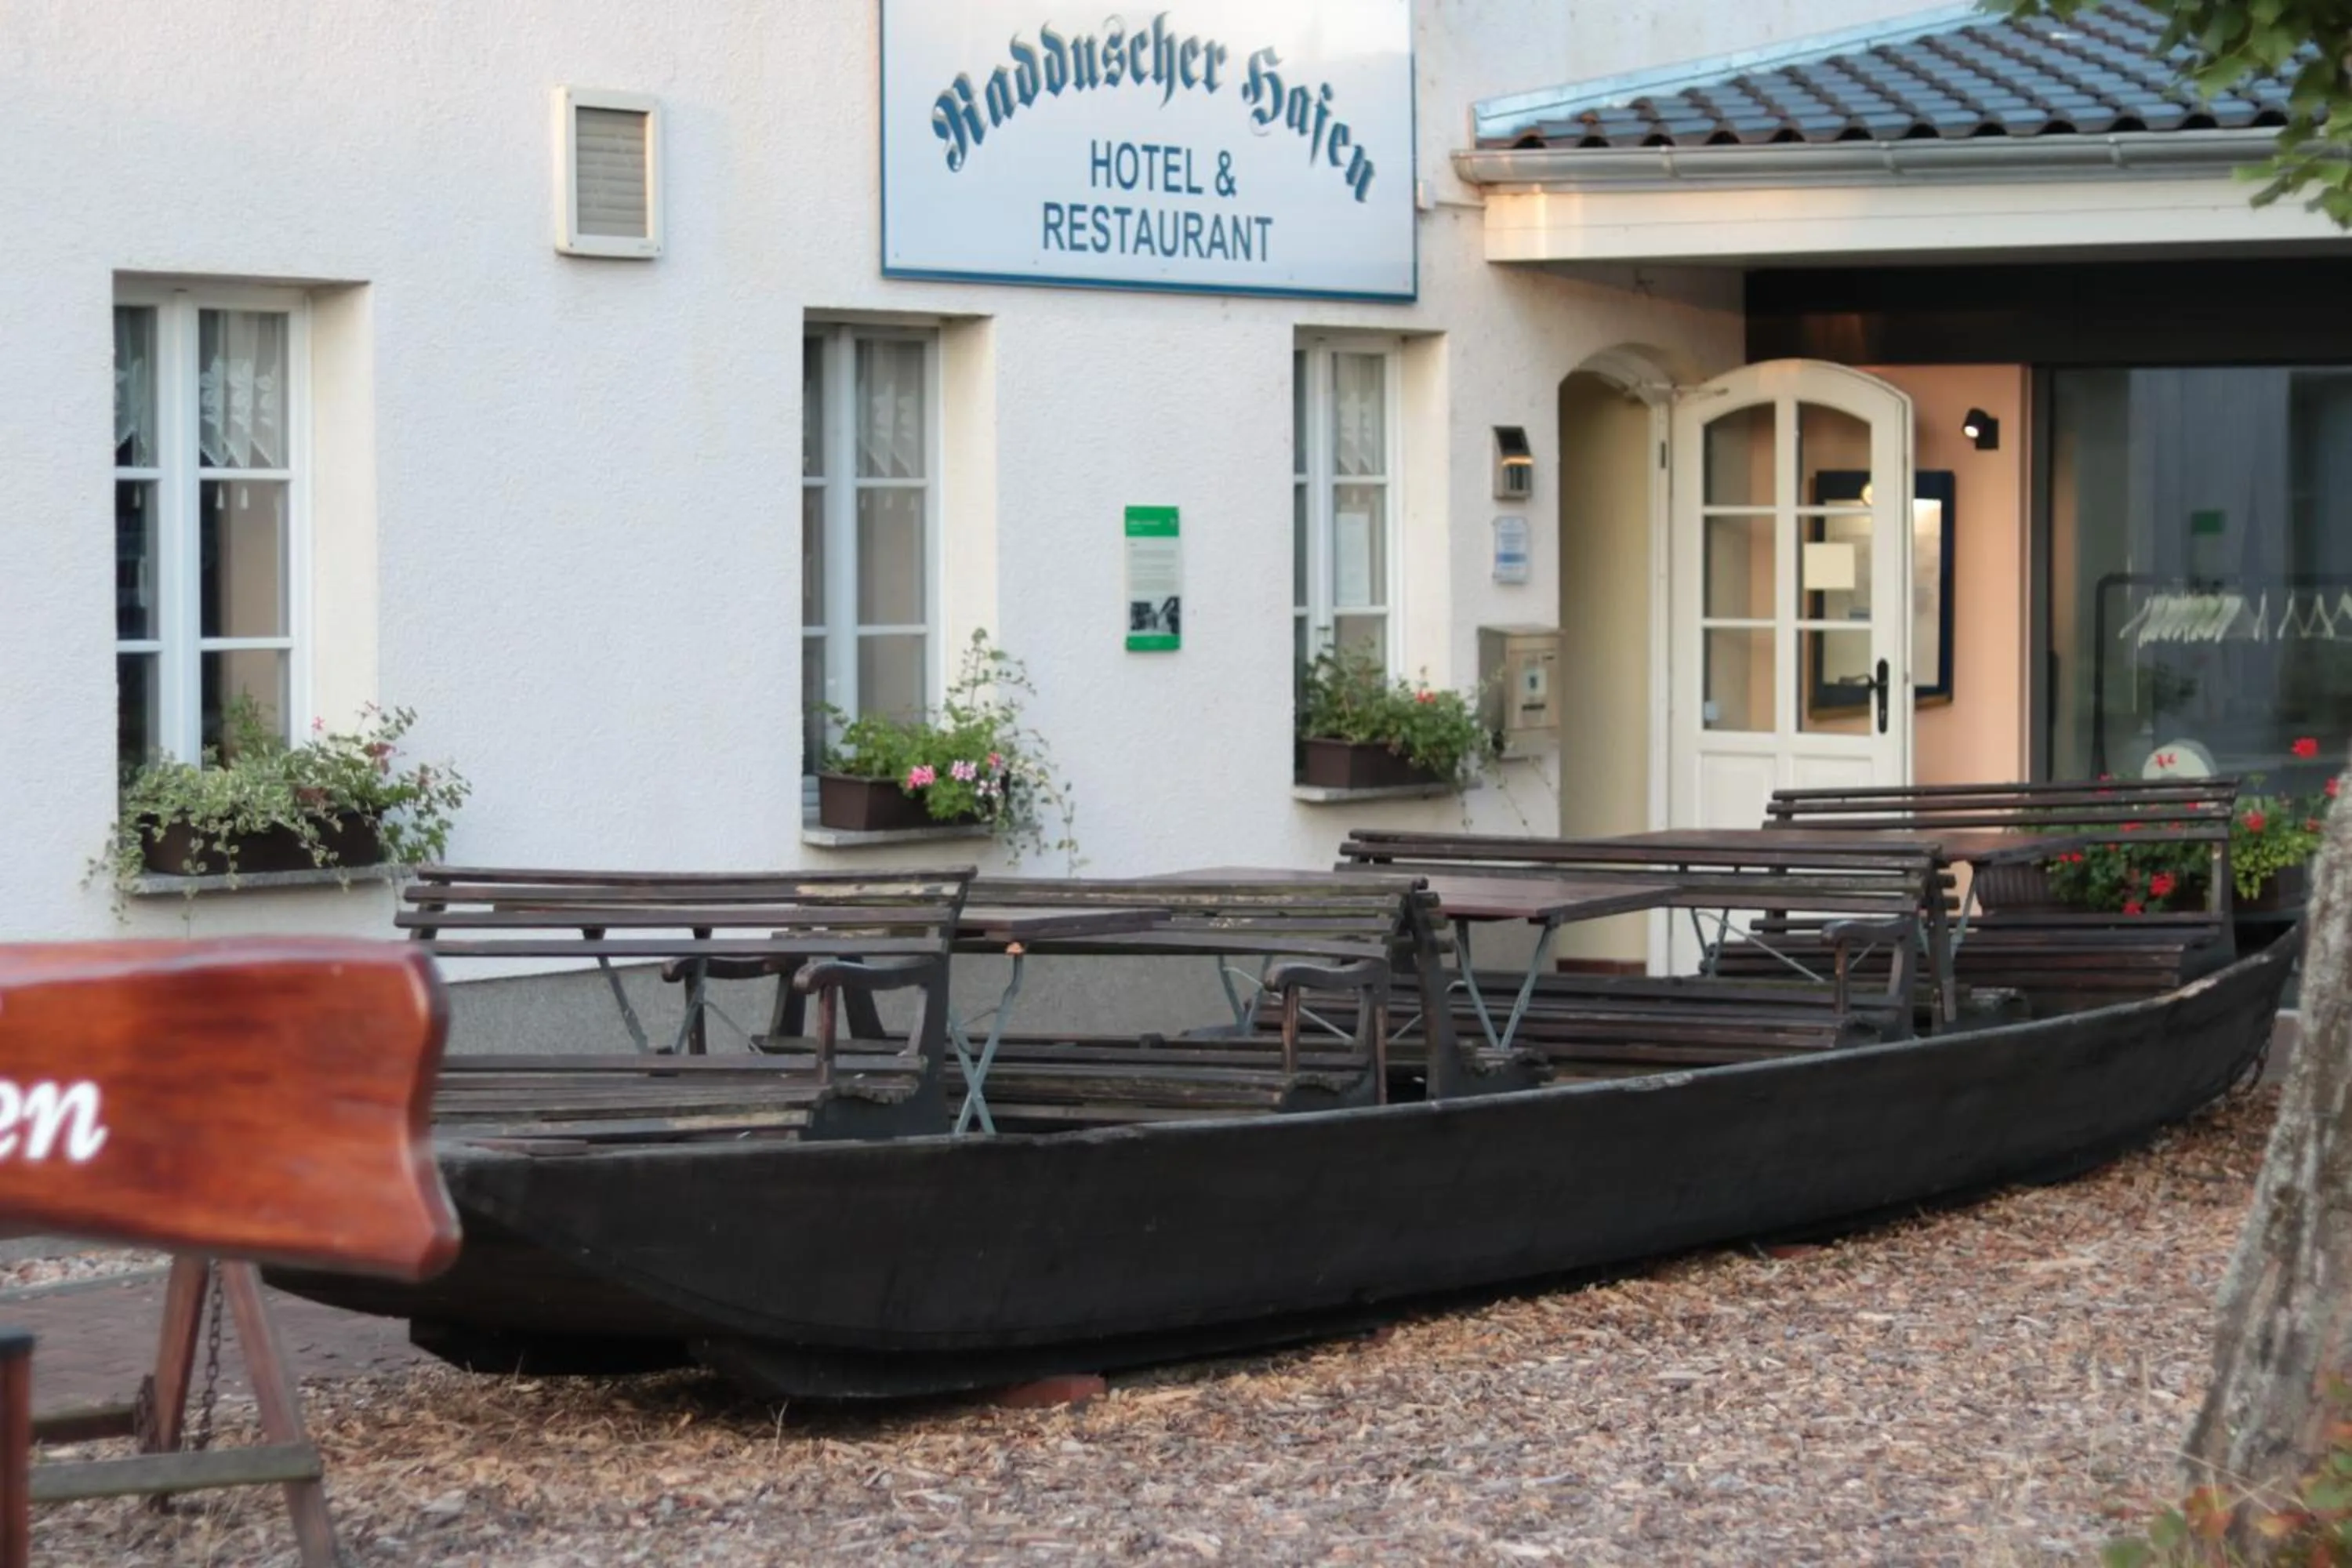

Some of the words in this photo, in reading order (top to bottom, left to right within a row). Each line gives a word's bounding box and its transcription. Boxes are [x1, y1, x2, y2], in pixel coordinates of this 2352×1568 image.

[931, 11, 1227, 172] Radduscher
[1242, 45, 1375, 204] Hafen
[1091, 140, 1203, 194] HOTEL
[1215, 150, 1237, 197] &
[1043, 201, 1273, 262] RESTAURANT
